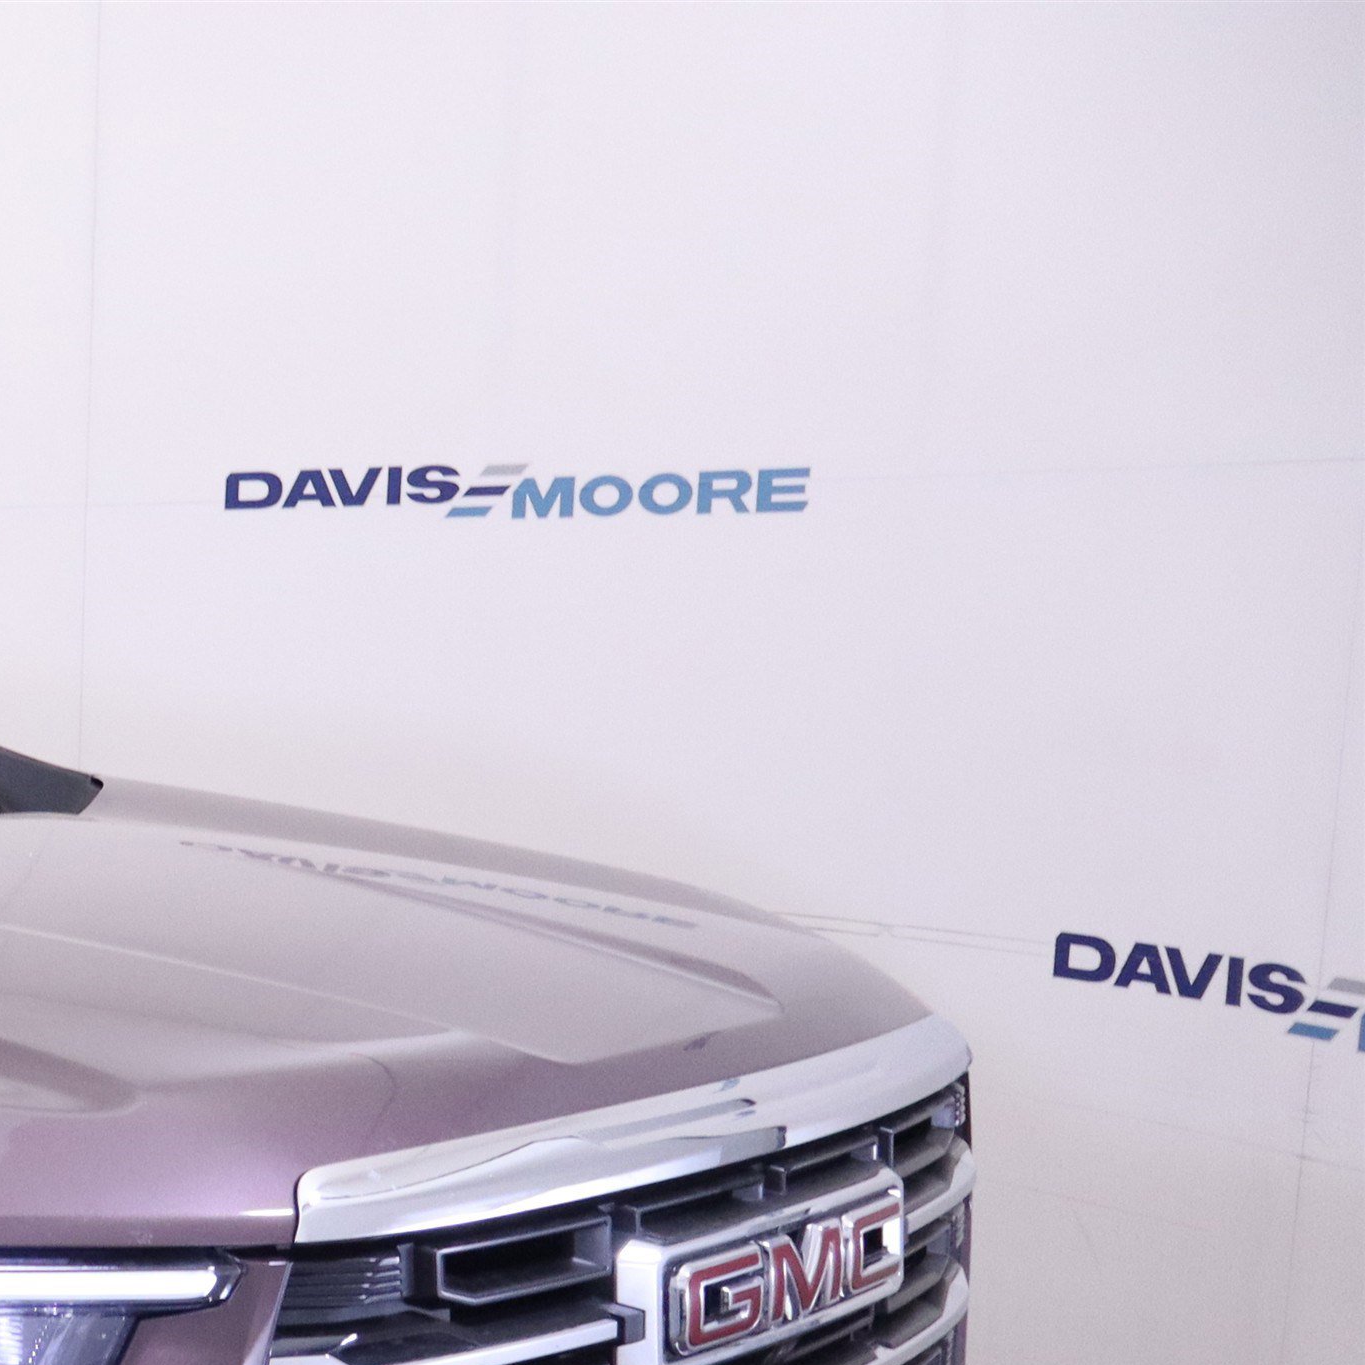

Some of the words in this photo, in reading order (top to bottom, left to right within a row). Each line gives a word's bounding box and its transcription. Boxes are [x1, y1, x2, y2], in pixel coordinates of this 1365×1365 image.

[224, 465, 461, 511] DAVIS
[510, 467, 811, 518] MOORE
[1053, 932, 1307, 1015] DAVIS
[670, 1200, 904, 1356] GMC
